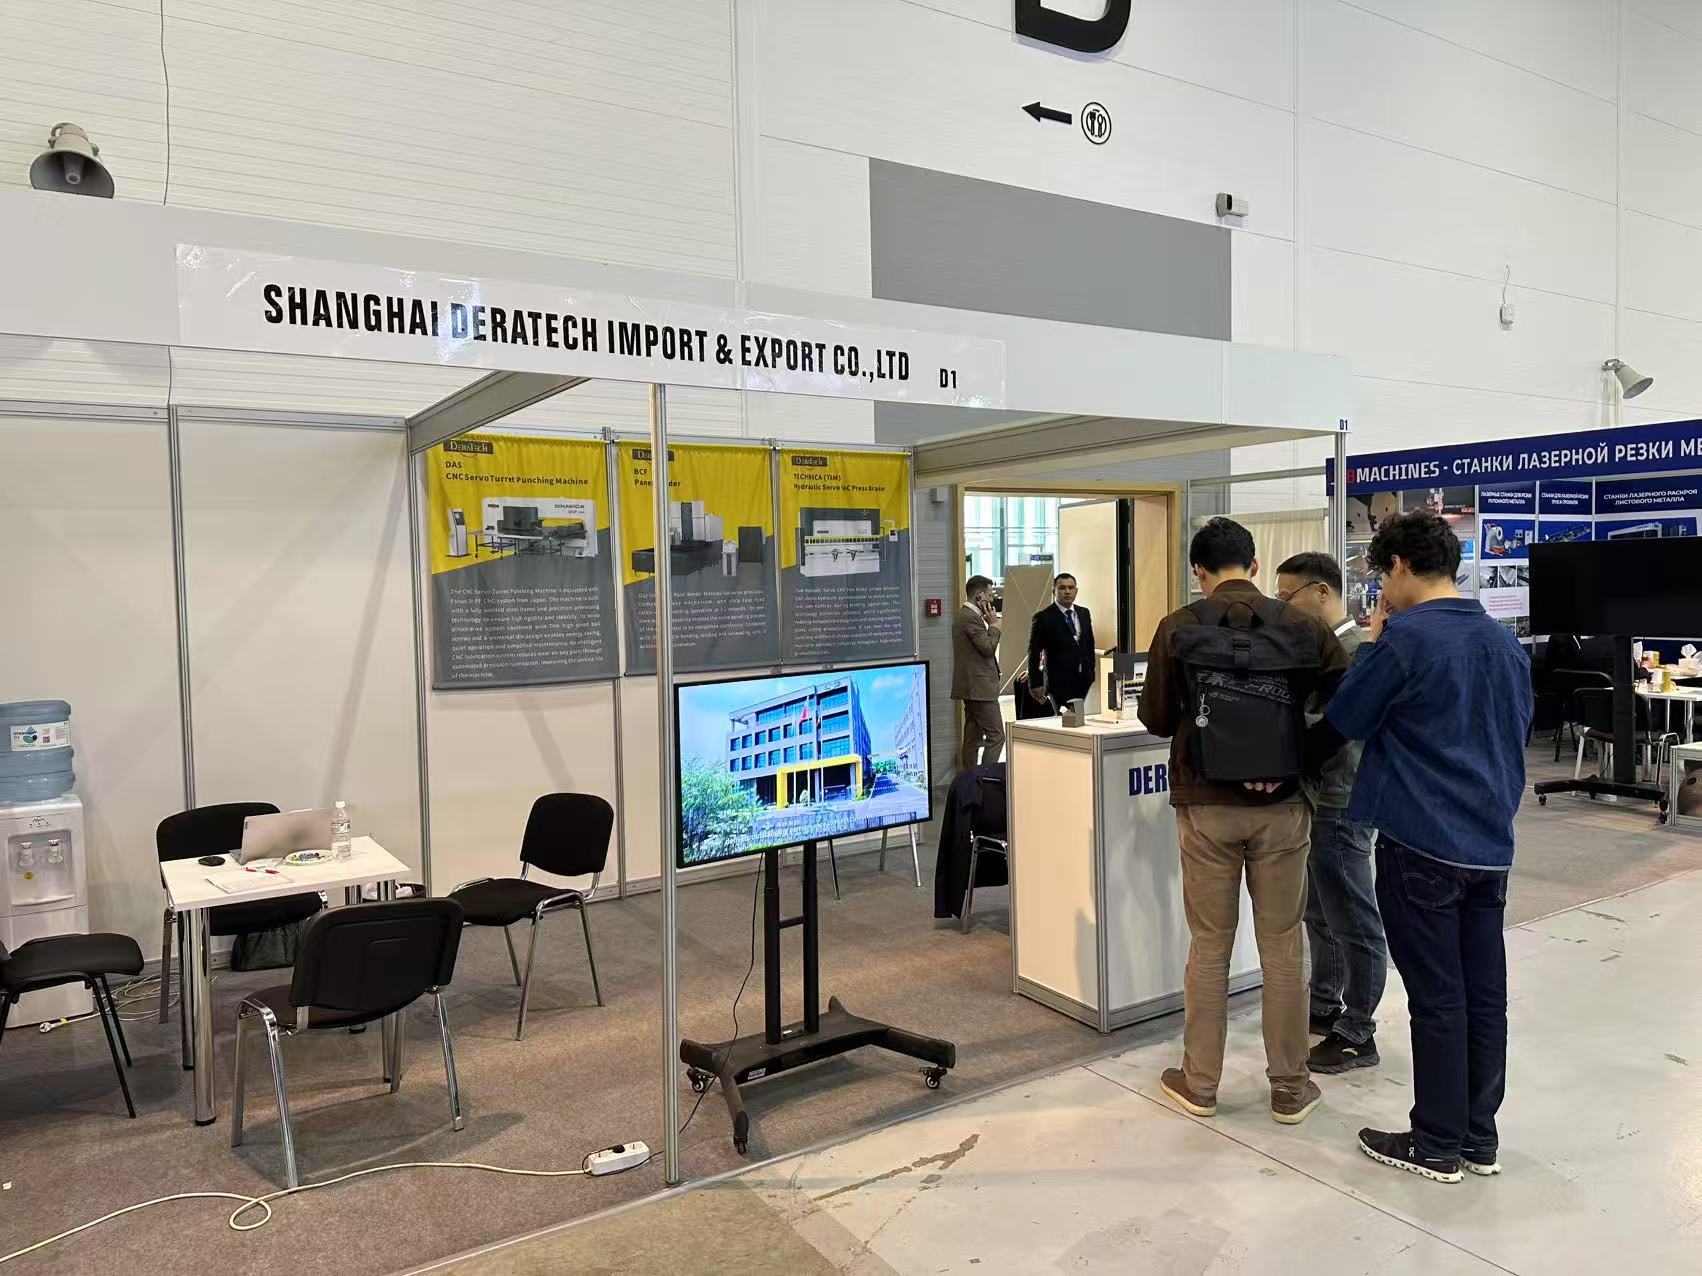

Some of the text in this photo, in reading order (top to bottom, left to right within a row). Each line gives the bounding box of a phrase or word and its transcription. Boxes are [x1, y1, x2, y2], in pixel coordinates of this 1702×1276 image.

[263, 283, 440, 338] SHANGHAI
[450, 302, 598, 352] DERATECH
[607, 319, 708, 363] IMPORT
[716, 333, 733, 365] &
[741, 334, 827, 373] EXPORT
[939, 368, 957, 389] D1
[516, 476, 554, 486] Punching
[1328, 461, 1440, 484] BMACHINES
[1452, 454, 1514, 475] СТАНКИ
[1517, 442, 1609, 470] ЛАЗЕРНОЙ
[1615, 440, 1673, 462] РЕЗКИ
[1128, 764, 1168, 796] DER
